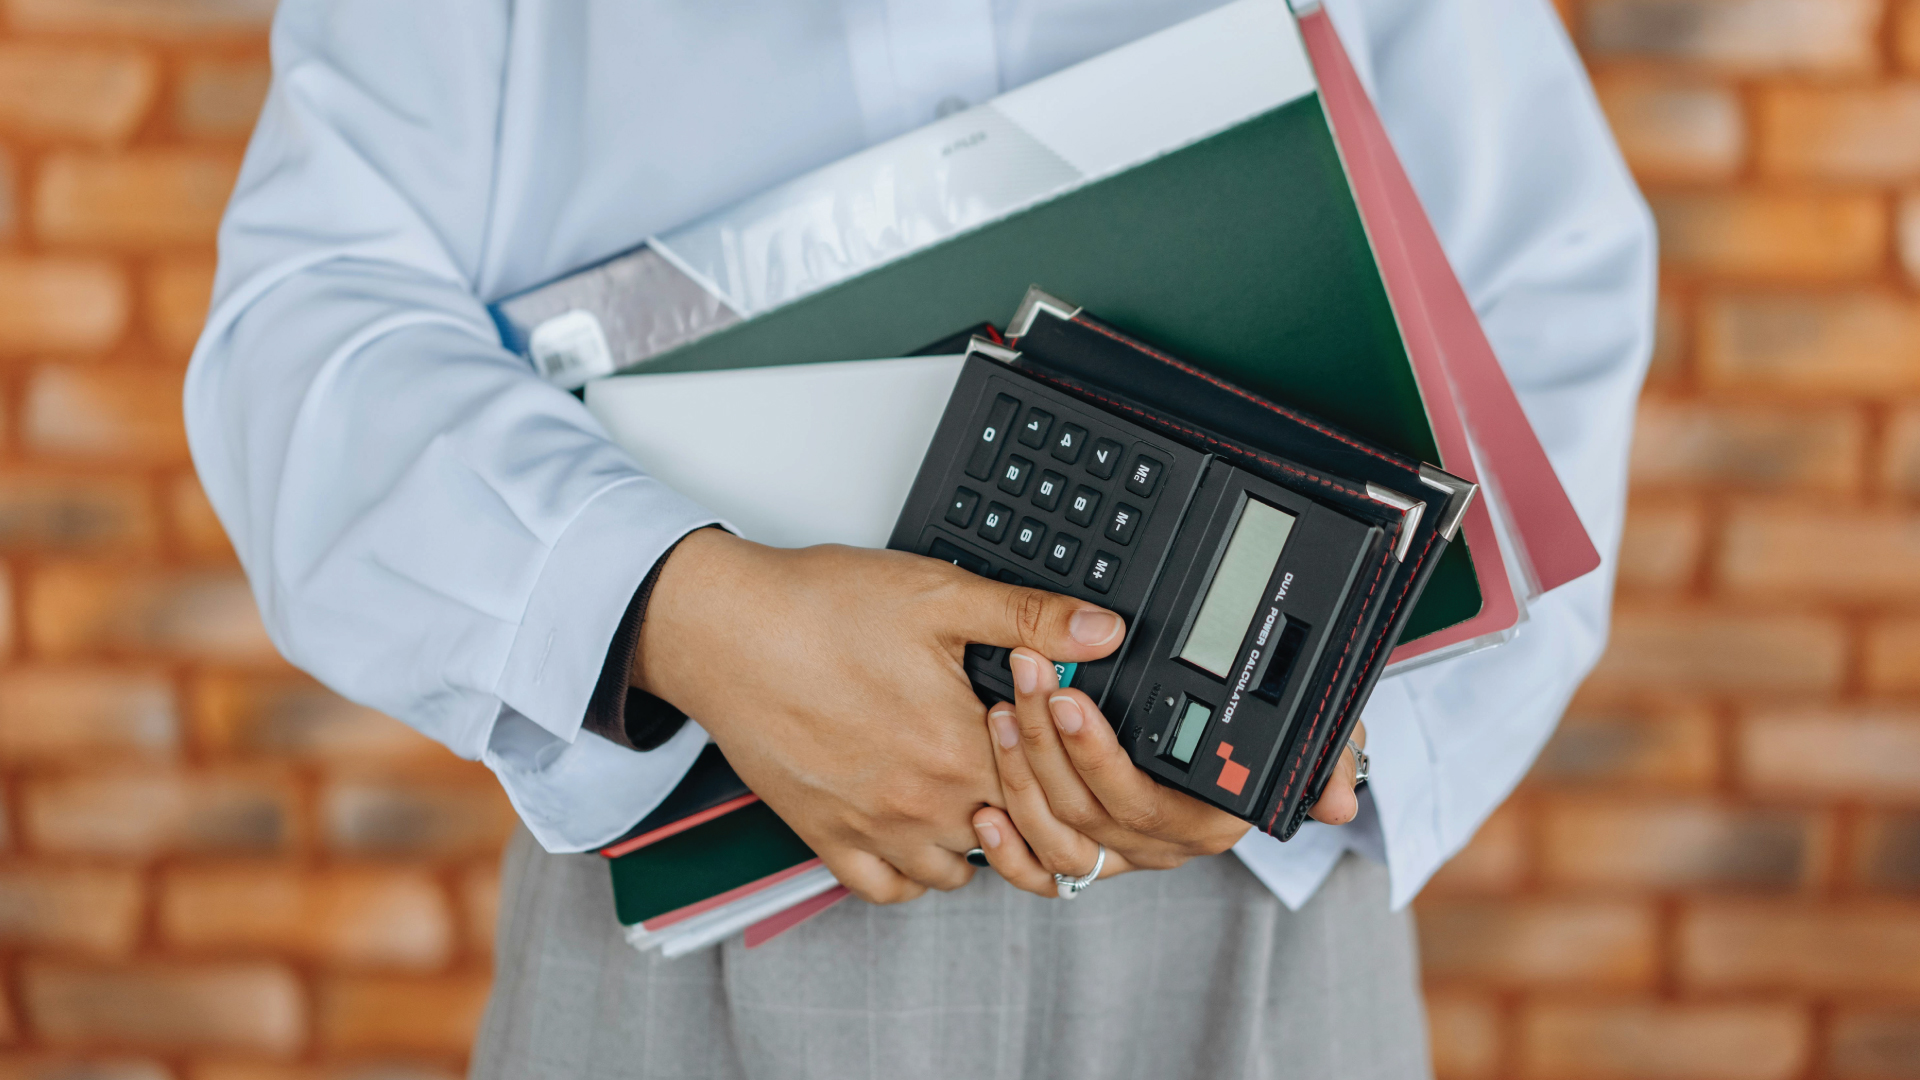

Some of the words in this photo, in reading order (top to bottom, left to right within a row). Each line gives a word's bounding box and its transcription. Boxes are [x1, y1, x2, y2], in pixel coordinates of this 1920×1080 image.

[1027, 421, 1039, 431] 1
[983, 427, 996, 442] 0
[1060, 433, 1072, 447] 4
[1096, 449, 1109, 464] 7
[1005, 465, 1019, 481] 2
[1040, 481, 1054, 496] 5
[1073, 496, 1087, 511] 8
[986, 513, 999, 528] 3
[1115, 511, 1129, 531] M-
[1019, 528, 1033, 543] 6
[1053, 544, 1066, 559] 9
[1092, 559, 1108, 579] M+
[1274, 572, 1294, 602] DUAL
[1256, 607, 1279, 646] POWER
[1222, 649, 1260, 724] CALCULATOR
